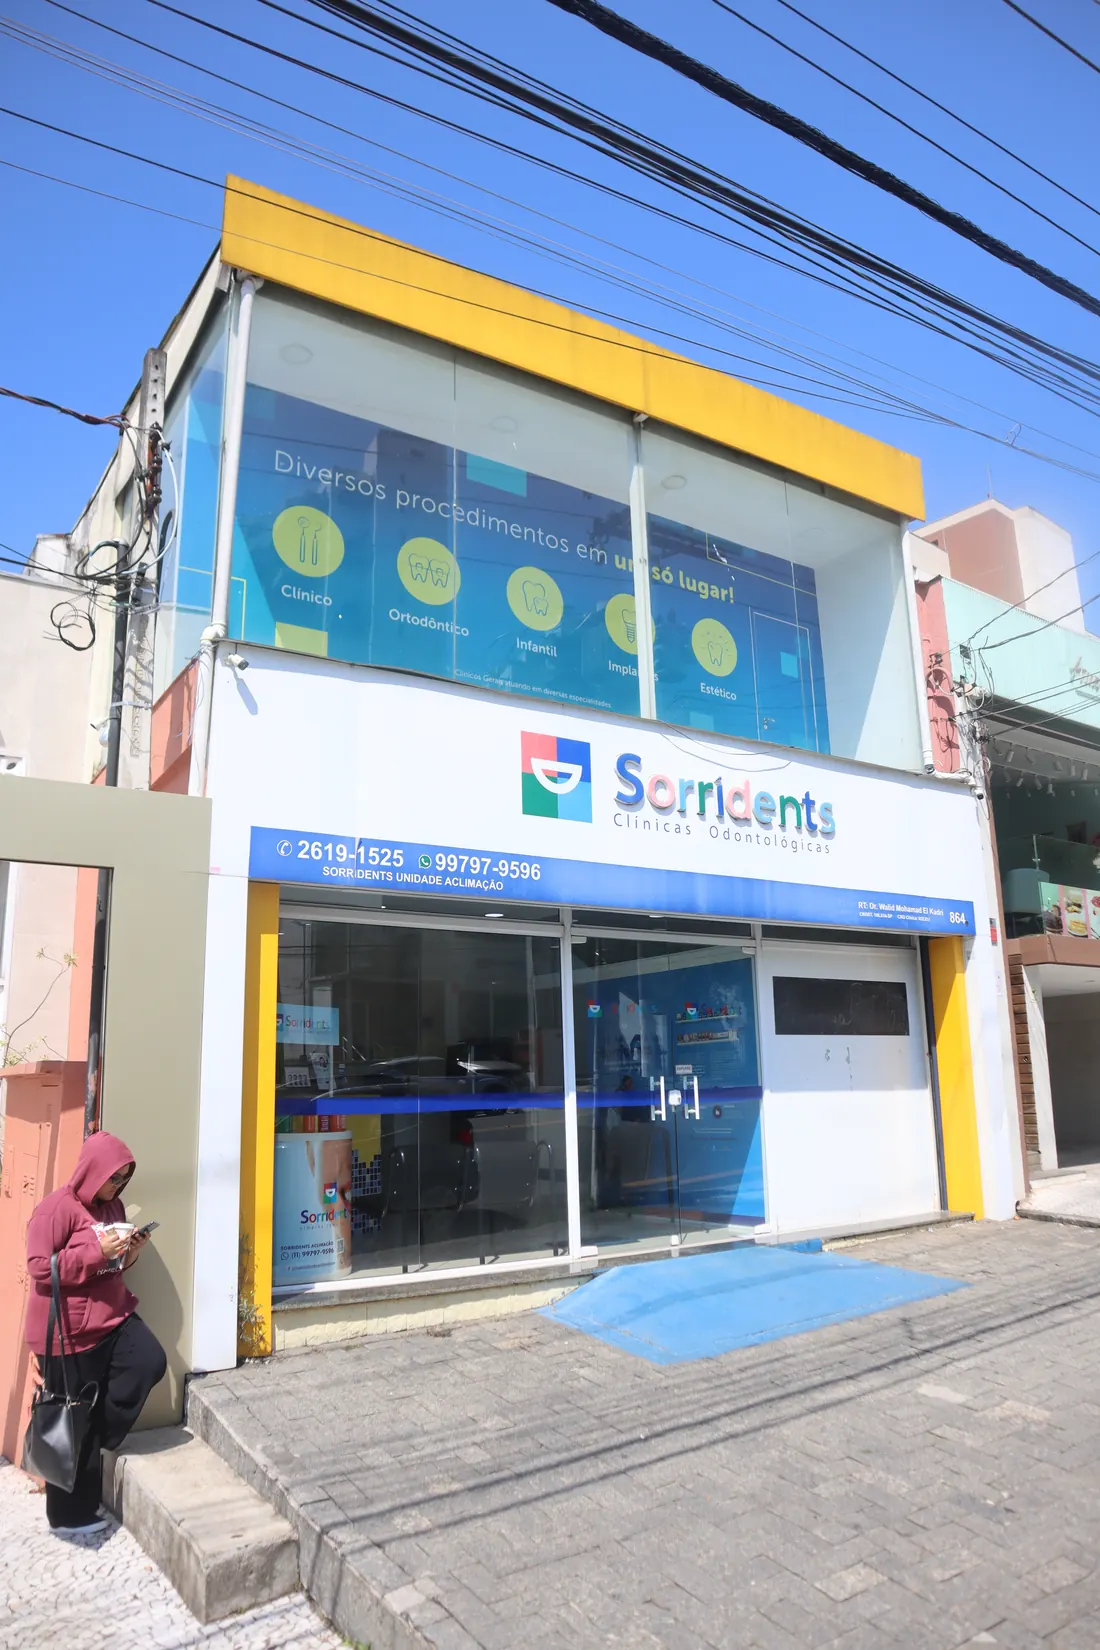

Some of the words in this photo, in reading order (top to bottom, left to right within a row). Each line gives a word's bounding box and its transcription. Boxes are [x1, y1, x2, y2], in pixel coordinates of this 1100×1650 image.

[275, 450, 386, 500] Diversos
[396, 490, 569, 552] procedimentos
[576, 545, 608, 565] em
[652, 566, 674, 584] só
[680, 571, 734, 604] lugar!
[281, 584, 332, 606] Clínico
[388, 608, 469, 637] Ortodôntico
[516, 637, 558, 658] Infantil
[505, 680, 530, 690] atuando
[544, 688, 568, 698] diversas
[700, 682, 737, 701] Estético
[614, 813, 692, 836] Clínicas
[709, 825, 830, 854] Odontológicas
[297, 840, 404, 867] 2619-1525
[435, 853, 541, 880] 99797-9596
[322, 866, 393, 882] SORRIDENTS
[396, 872, 442, 885] UNIDADE
[444, 876, 504, 892] ACLIMAÇÃO
[950, 912, 966, 924] 864
